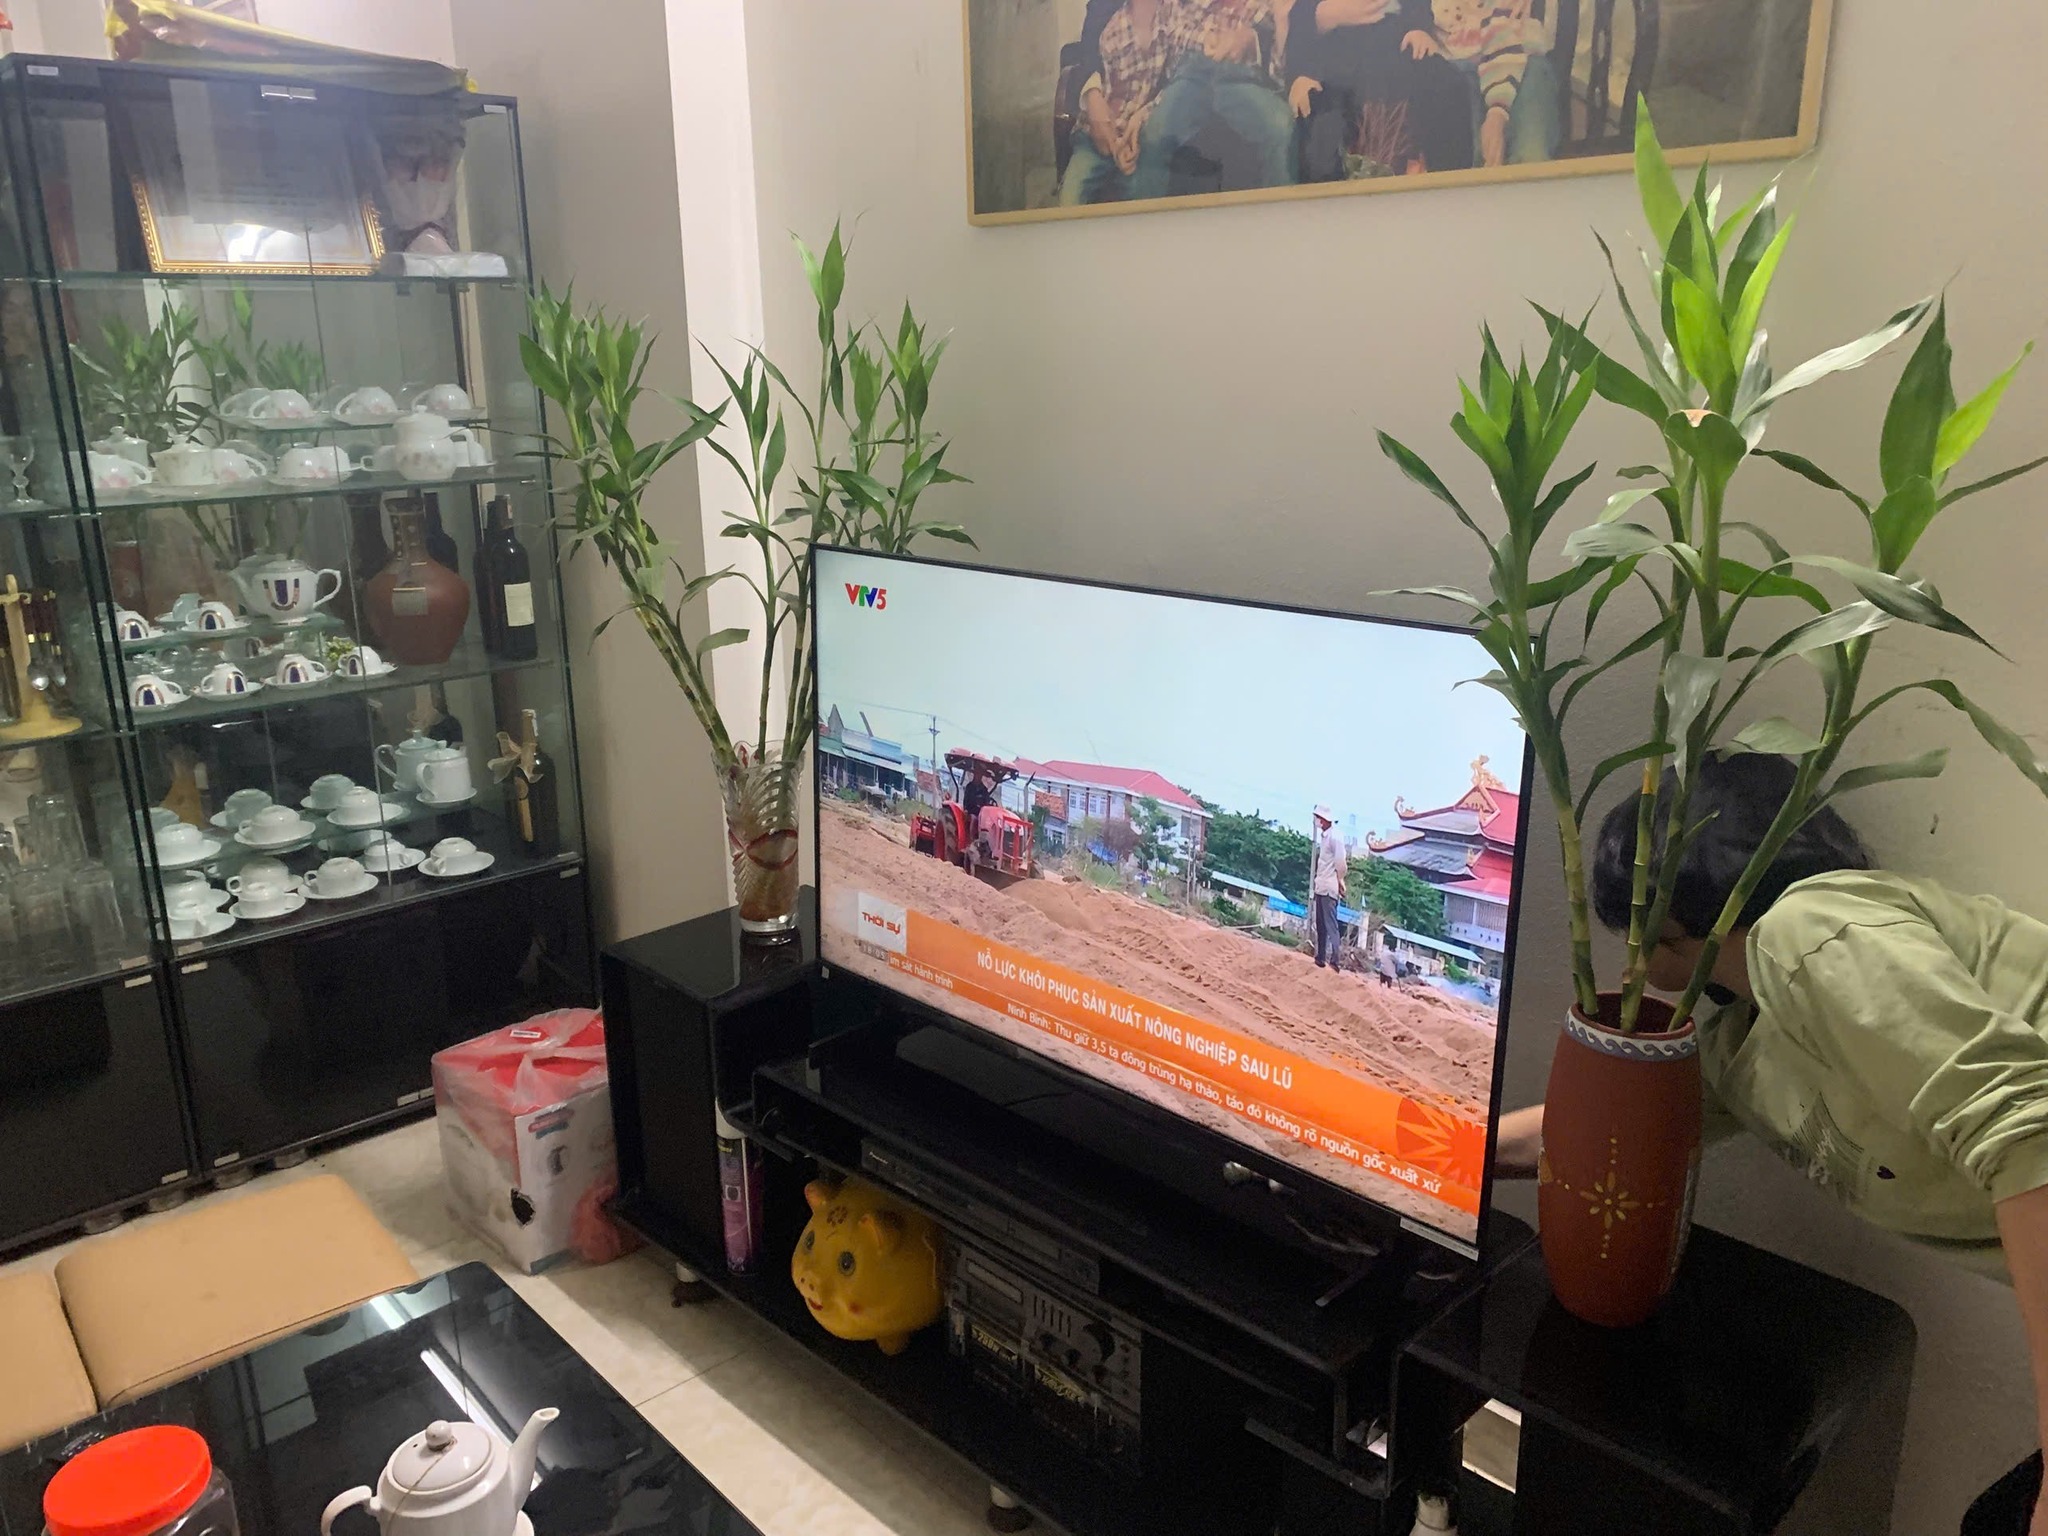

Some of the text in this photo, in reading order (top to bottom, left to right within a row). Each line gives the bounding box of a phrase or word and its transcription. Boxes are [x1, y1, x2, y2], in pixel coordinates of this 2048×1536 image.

[844, 583, 887, 610] VTV5
[862, 911, 901, 935] THỜI SỰ
[914, 963, 933, 981] hành
[935, 973, 954, 990] trình
[977, 948, 1293, 1090] NỖ LỰC KHÔI PHỤC SẢN XUẤT NÔNG NGHIỆP SAU LŨ
[1007, 1003, 1027, 1020] Ninh
[1054, 1021, 1072, 1039] Thu
[1073, 1032, 1090, 1046] giữ
[1091, 1037, 1107, 1054] 3,5
[1108, 1044, 1119, 1061] tạ
[1121, 1050, 1147, 1073] đông
[1148, 1062, 1177, 1086] trùng
[1178, 1071, 1192, 1092] hạ
[1195, 1079, 1223, 1105] thảo,
[1225, 1093, 1244, 1111] táo
[1246, 1101, 1262, 1119] đỏ
[1265, 1109, 1301, 1138] không
[1304, 1127, 1317, 1143] rõ
[1320, 1136, 1359, 1161] nguồn
[1421, 1178, 1442, 1194] xứ
